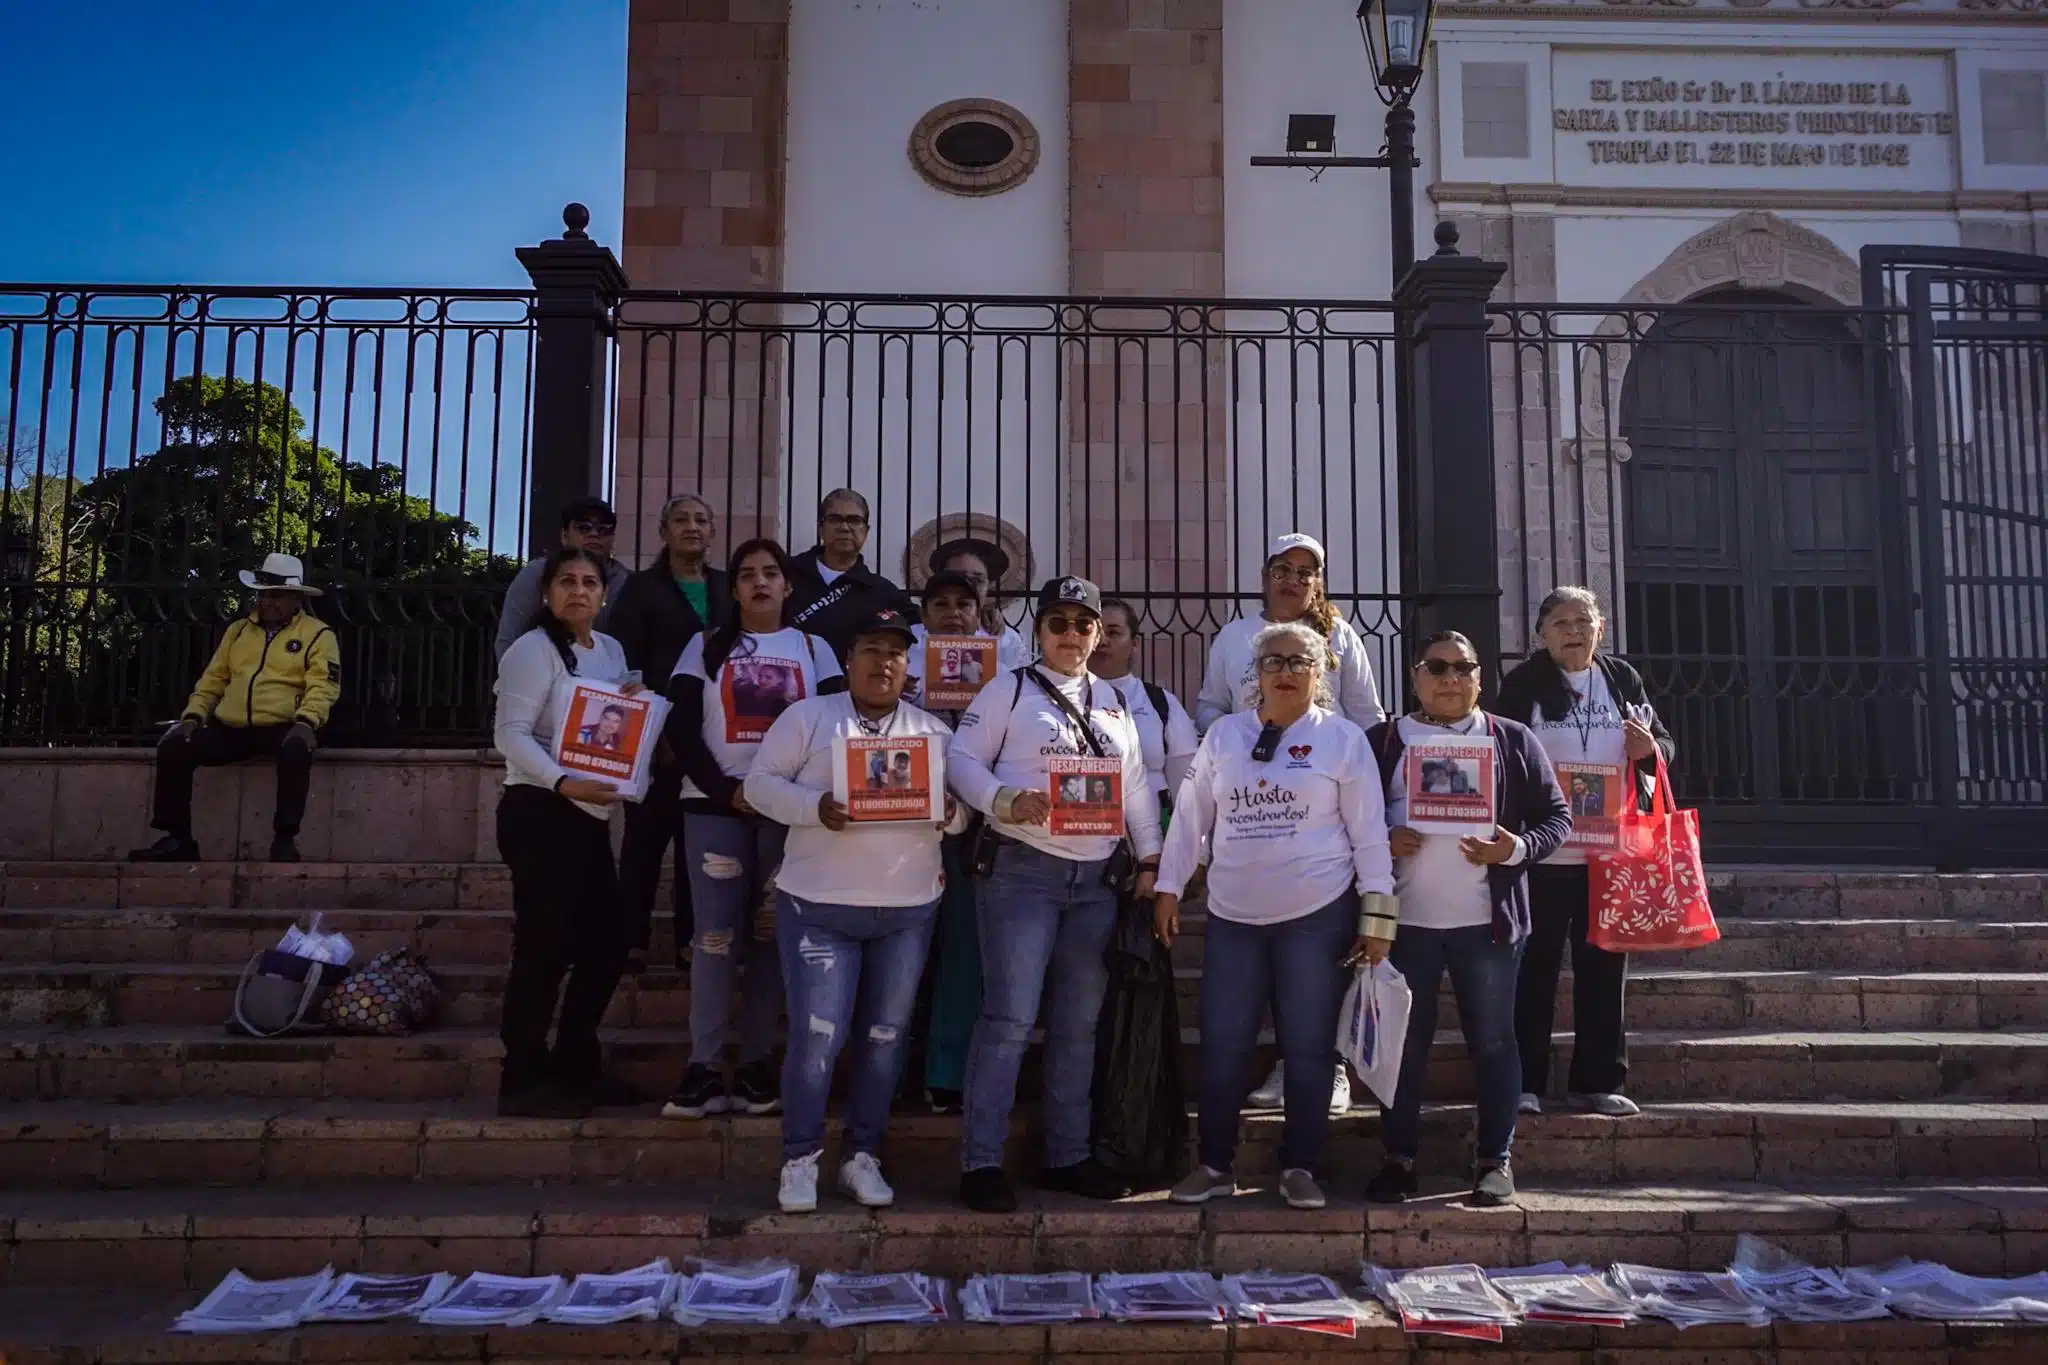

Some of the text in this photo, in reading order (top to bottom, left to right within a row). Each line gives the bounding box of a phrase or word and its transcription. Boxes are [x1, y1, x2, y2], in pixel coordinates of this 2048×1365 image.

[1590, 79, 1618, 102] EL
[1847, 82, 1877, 105] DE
[1880, 81, 1912, 106] LA
[1553, 108, 1620, 132] GARZA
[1625, 108, 1640, 132] Y
[1643, 108, 1790, 134] BALLESTEROS
[1896, 111, 1953, 135] ESTE
[1586, 139, 1672, 165] TEMPLO
[1675, 140, 1705, 165] EL
[1708, 141, 1736, 165] 22
[1738, 141, 1767, 166] DE
[1828, 143, 1857, 166] DE
[930, 641, 993, 649] DESAPARECIDO
[1414, 746, 1489, 758] DESAPARECIDO
[1050, 760, 1120, 774] DESAPARECIDO
[1230, 784, 1297, 812] Hasta
